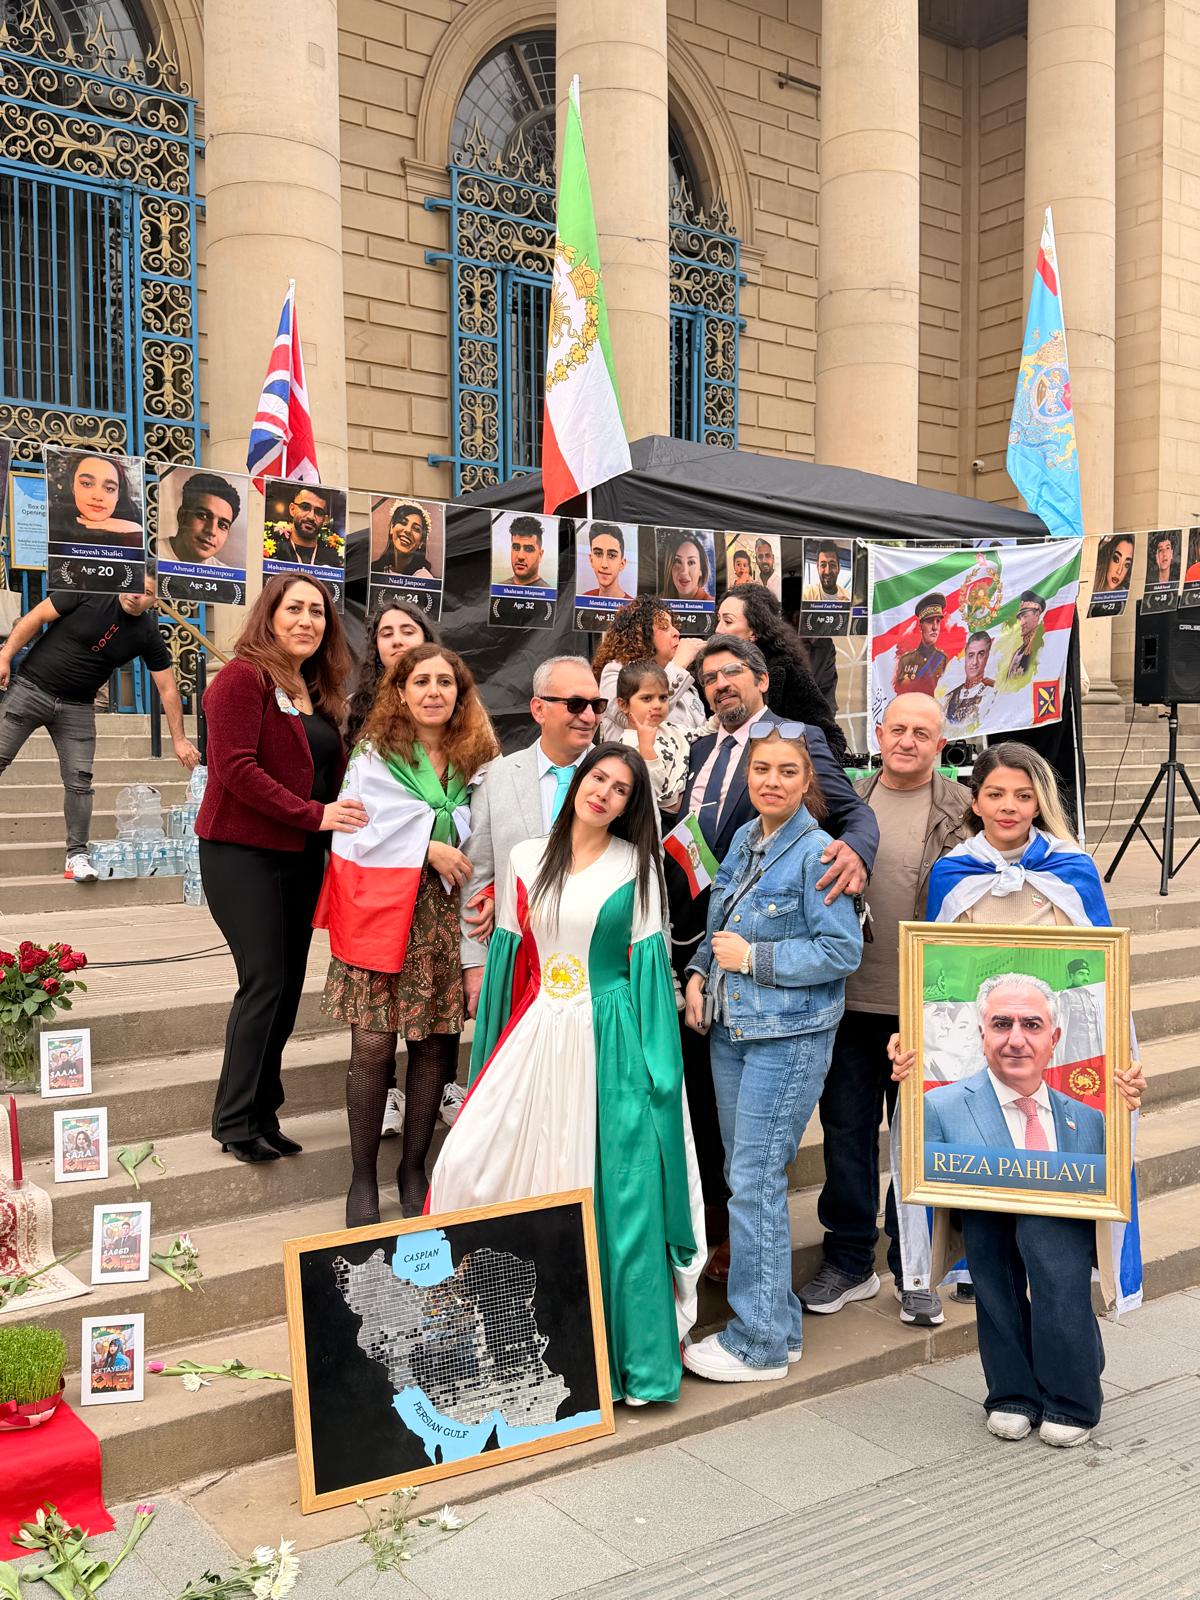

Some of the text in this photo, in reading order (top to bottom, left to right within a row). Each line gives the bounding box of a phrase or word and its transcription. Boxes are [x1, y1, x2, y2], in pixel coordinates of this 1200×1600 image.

[71, 547, 100, 557] Setayesh
[80, 565, 114, 577] Age 20
[173, 564, 235, 578] Ahmad Ebrahimpour
[267, 563, 300, 572] Mohammad
[189, 581, 218, 592] Age 34
[393, 593, 419, 603] Age 24
[513, 601, 535, 610] Age 32
[594, 613, 615, 621] Age 15
[686, 615, 697, 623] 42
[825, 615, 834, 624] 39
[91, 623, 120, 652] HUGO
[793, 1040, 811, 1078] GUESS
[50, 1068, 77, 1078] SAAM
[768, 1127, 784, 1165] GUESS
[65, 1149, 92, 1160] SARA
[932, 1151, 1097, 1184] REZA PAHLAVI
[103, 1247, 130, 1257] SAEED
[403, 1248, 440, 1264] CASPIAN
[414, 1262, 430, 1273] SEA
[93, 1364, 130, 1376] SETAYESH
[413, 1400, 470, 1439] PERSIAN GULF
